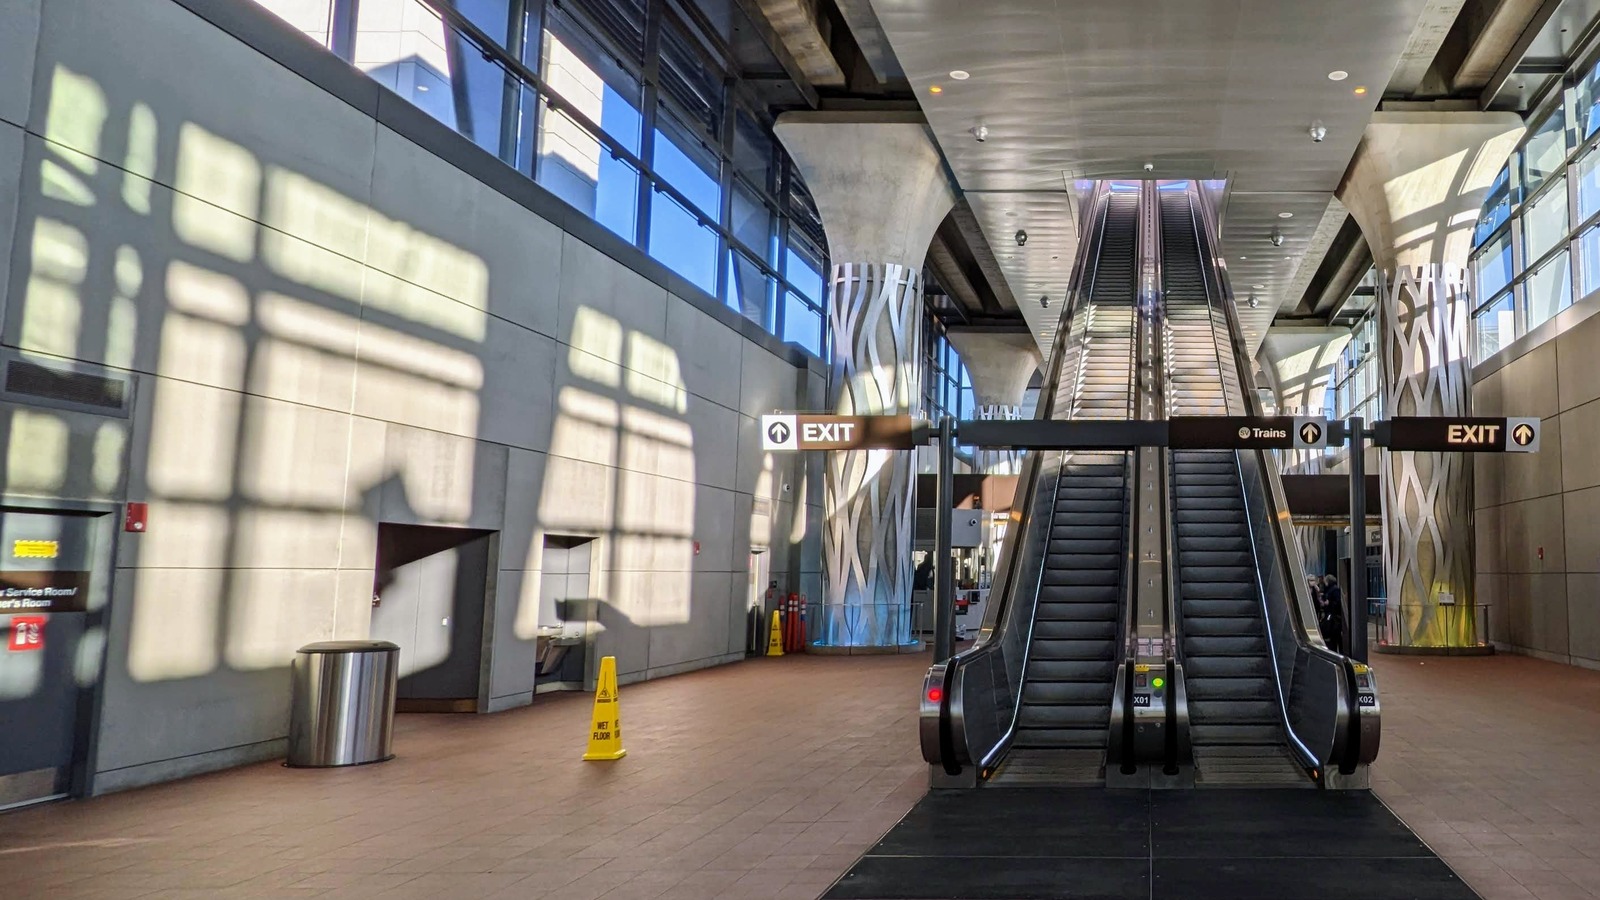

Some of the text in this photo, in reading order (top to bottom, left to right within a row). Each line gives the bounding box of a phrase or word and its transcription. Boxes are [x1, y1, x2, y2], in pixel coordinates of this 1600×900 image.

[802, 423, 854, 442] EXIT
[1252, 428, 1287, 438] Trains
[1447, 424, 1500, 444] EXIT
[6, 587, 43, 597] Service
[22, 598, 51, 607] Room
[1133, 696, 1149, 704] X01
[597, 721, 609, 730] WET
[592, 731, 611, 740] FLOOR
